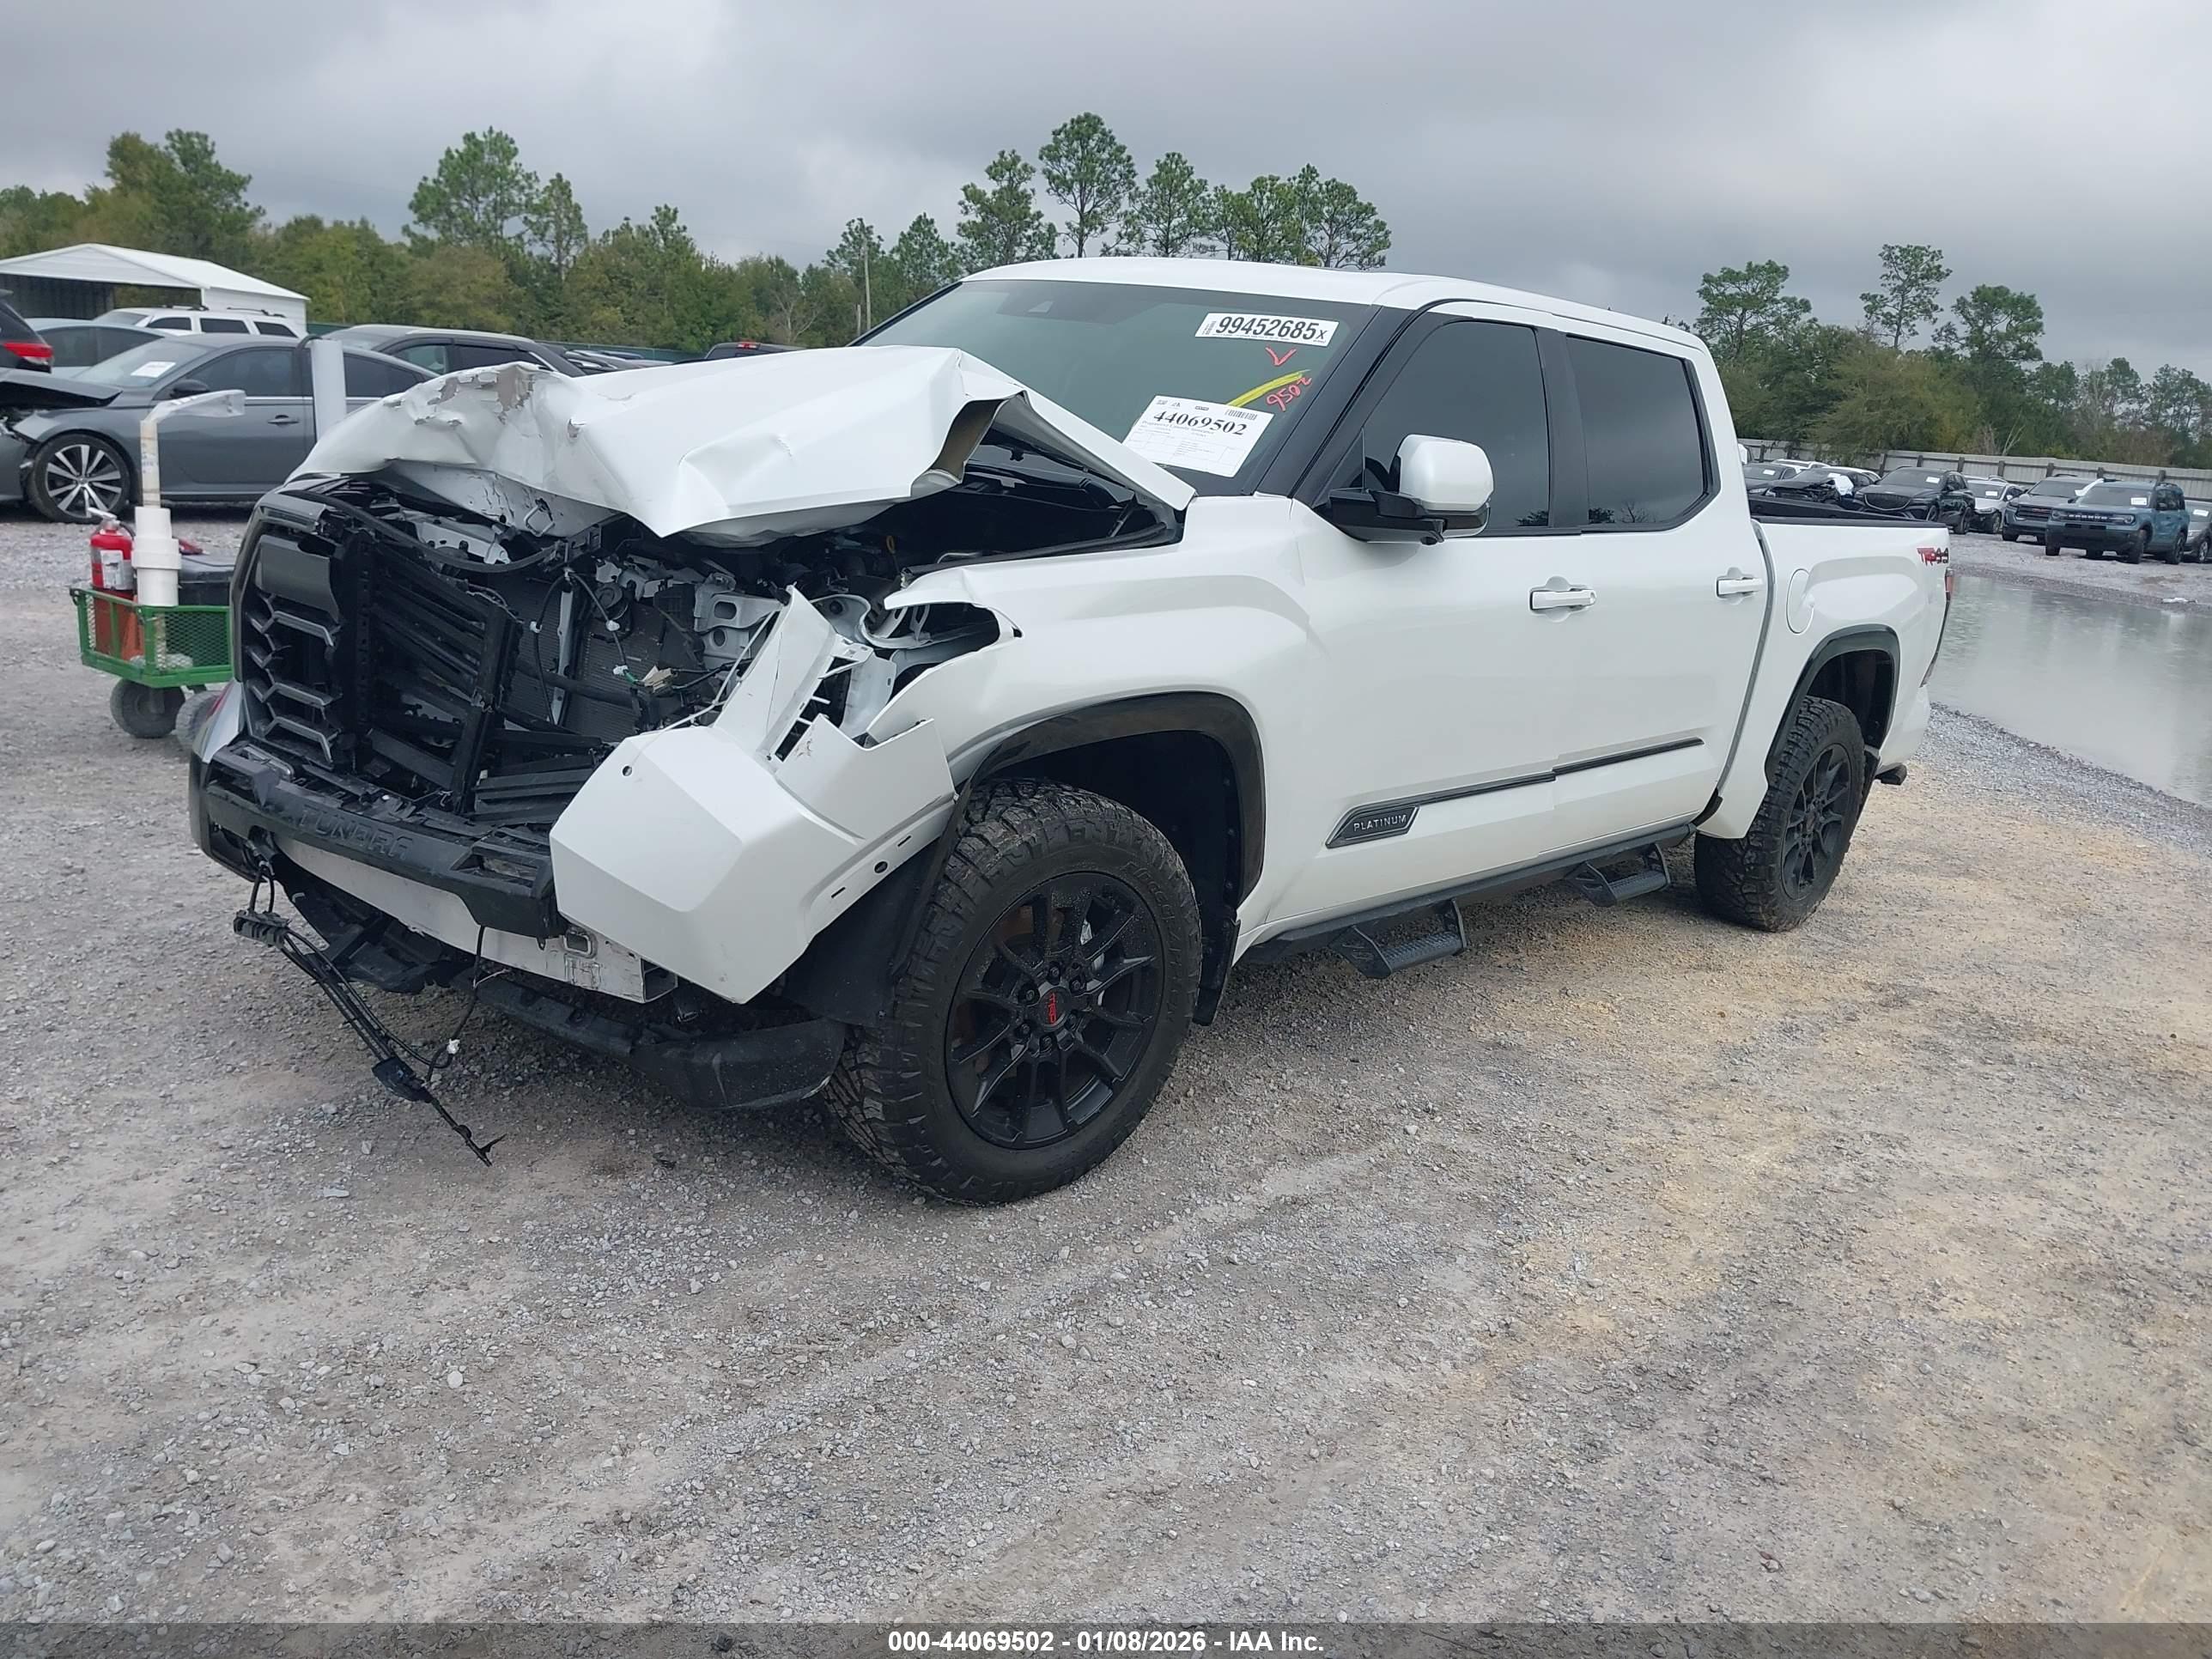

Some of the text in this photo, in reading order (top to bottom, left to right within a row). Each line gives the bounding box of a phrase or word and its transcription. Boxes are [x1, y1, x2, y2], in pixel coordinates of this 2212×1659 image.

[1153, 410, 1248, 435] 44069502
[299, 805, 414, 860] TUNDRA
[1353, 814, 1407, 832] PLATINUM
